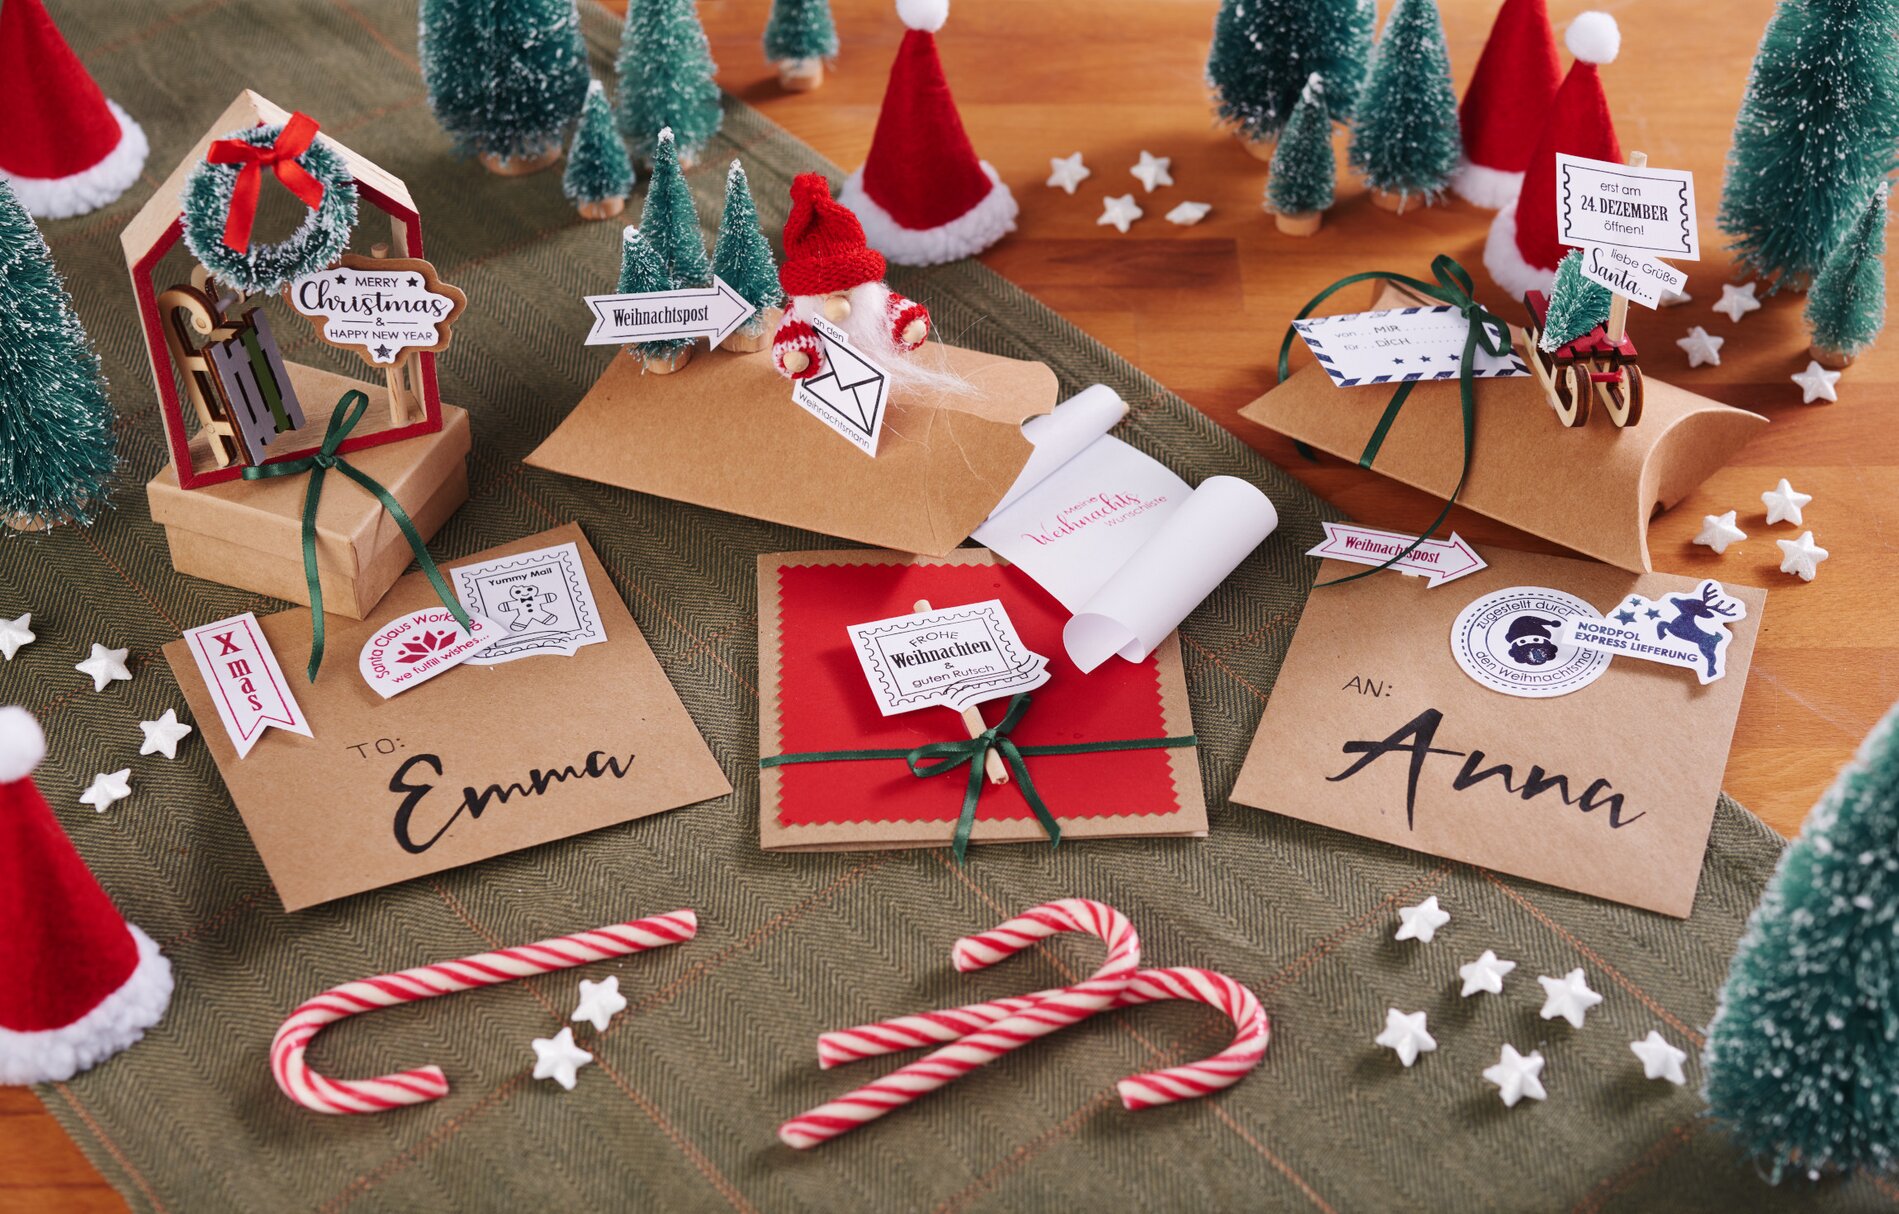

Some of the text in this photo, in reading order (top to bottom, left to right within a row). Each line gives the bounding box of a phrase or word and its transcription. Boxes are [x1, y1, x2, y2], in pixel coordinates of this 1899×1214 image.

[1600, 182, 1641, 197] erst am
[1580, 194, 1669, 222] 24. DEZEMBER
[1604, 220, 1645, 236] öffnen!
[1610, 248, 1678, 286] liebe Grüße
[355, 277, 399, 288] MERRY
[300, 279, 448, 318] Christmas
[375, 317, 385, 327] &
[613, 304, 709, 327] Weihnachtspost
[330, 329, 432, 341] HAPPY NEW YEAR
[813, 317, 844, 342] an den
[799, 392, 870, 449] Weihnachtsmann
[1021, 491, 1141, 545] Weihnachts
[1063, 496, 1097, 516] Meine
[1104, 496, 1168, 527] Wunschliste
[488, 567, 553, 587] Yummy Mail
[1476, 600, 1531, 630] zugestellt
[374, 622, 412, 647] Claus
[909, 630, 959, 648] FROHE
[1578, 621, 1641, 642] NORDPOL
[889, 640, 993, 670] Weihnachten
[1574, 631, 1699, 663] EXPRESS LIEFERUNG
[391, 672, 412, 684] we
[412, 657, 441, 675] fulfill
[944, 661, 954, 670] &
[1475, 650, 1497, 671] den
[912, 663, 995, 689] guten Rutsch
[1342, 675, 1393, 698] AN:
[346, 737, 405, 759] TO:
[1325, 708, 1646, 831] Anna
[389, 750, 636, 854] Emma
